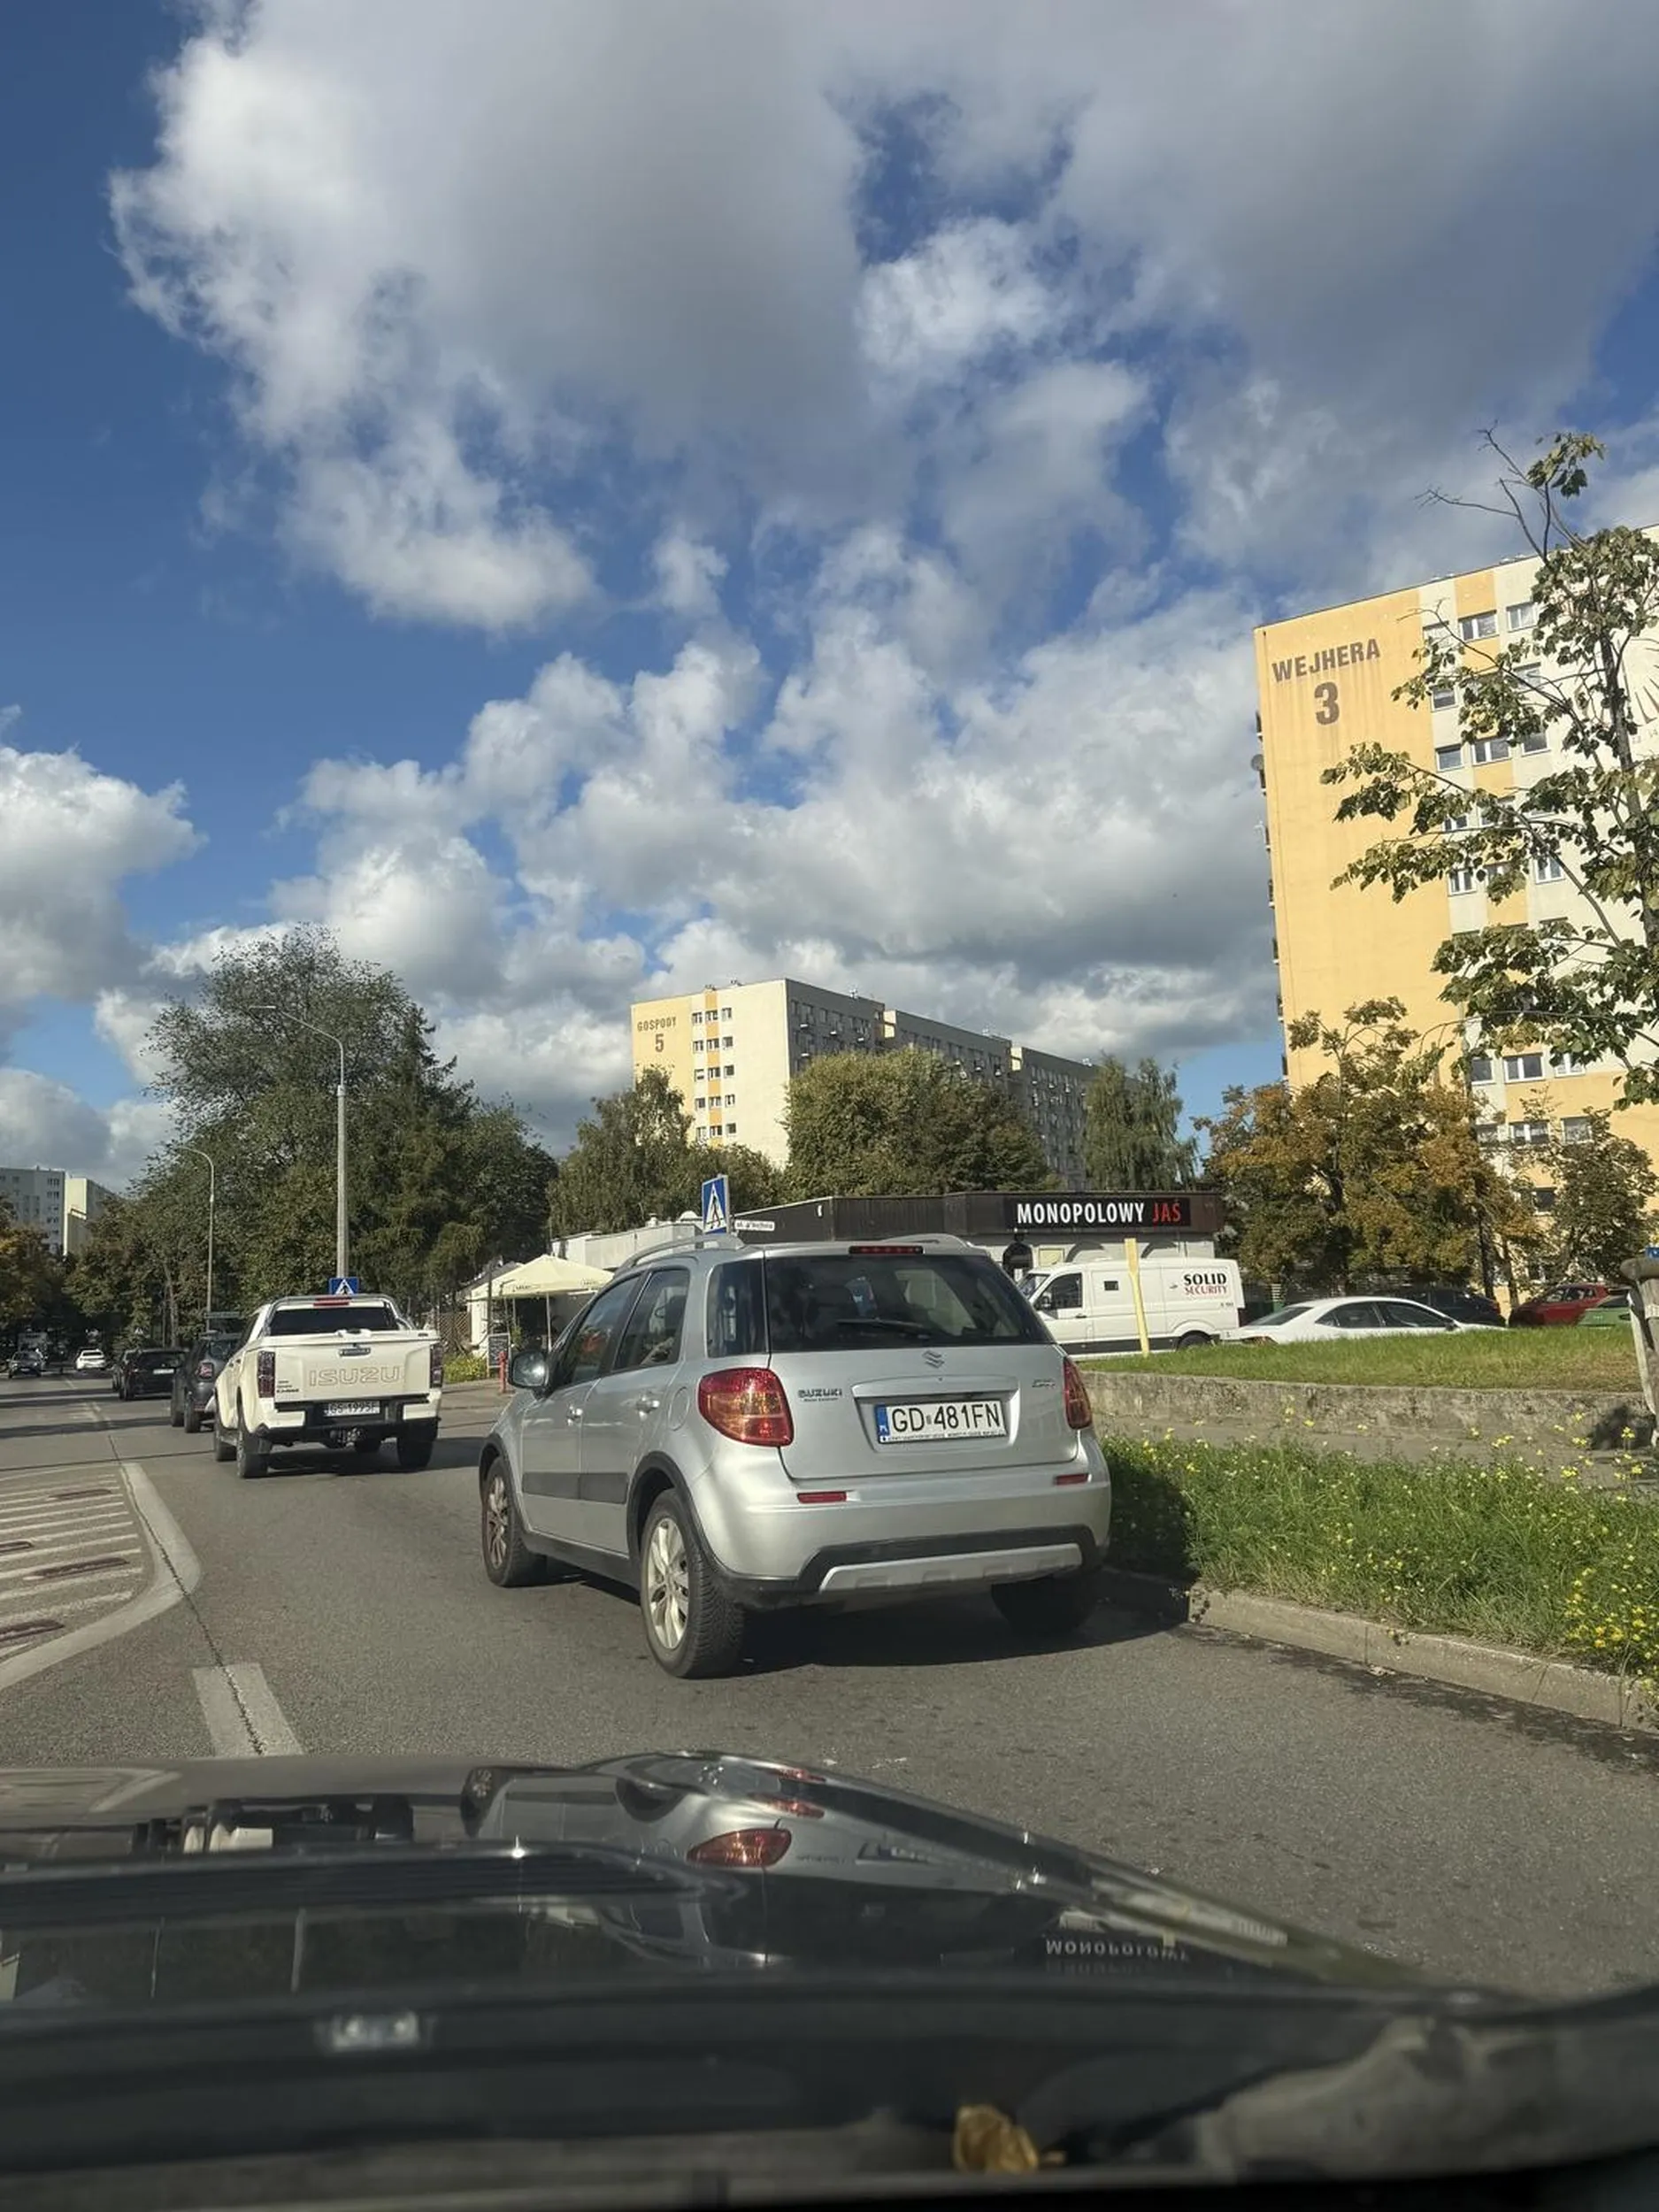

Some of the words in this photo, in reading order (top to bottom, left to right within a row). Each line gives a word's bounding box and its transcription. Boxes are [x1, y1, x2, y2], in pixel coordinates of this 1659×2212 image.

[1271, 638, 1381, 683] WEJHERA
[1314, 681, 1340, 726] 3
[637, 1016, 677, 1032] GOSPODY
[655, 1033, 664, 1053] 5
[1017, 1202, 1144, 1225] MONOPOLOWY
[1152, 1198, 1181, 1223] JAŚ
[1183, 1272, 1227, 1286] SOLID
[1184, 1285, 1228, 1295] SECURITY
[309, 1366, 400, 1386] ISUZU
[798, 1388, 842, 1398] SUZUKI
[933, 1403, 1001, 1430] 481FN
